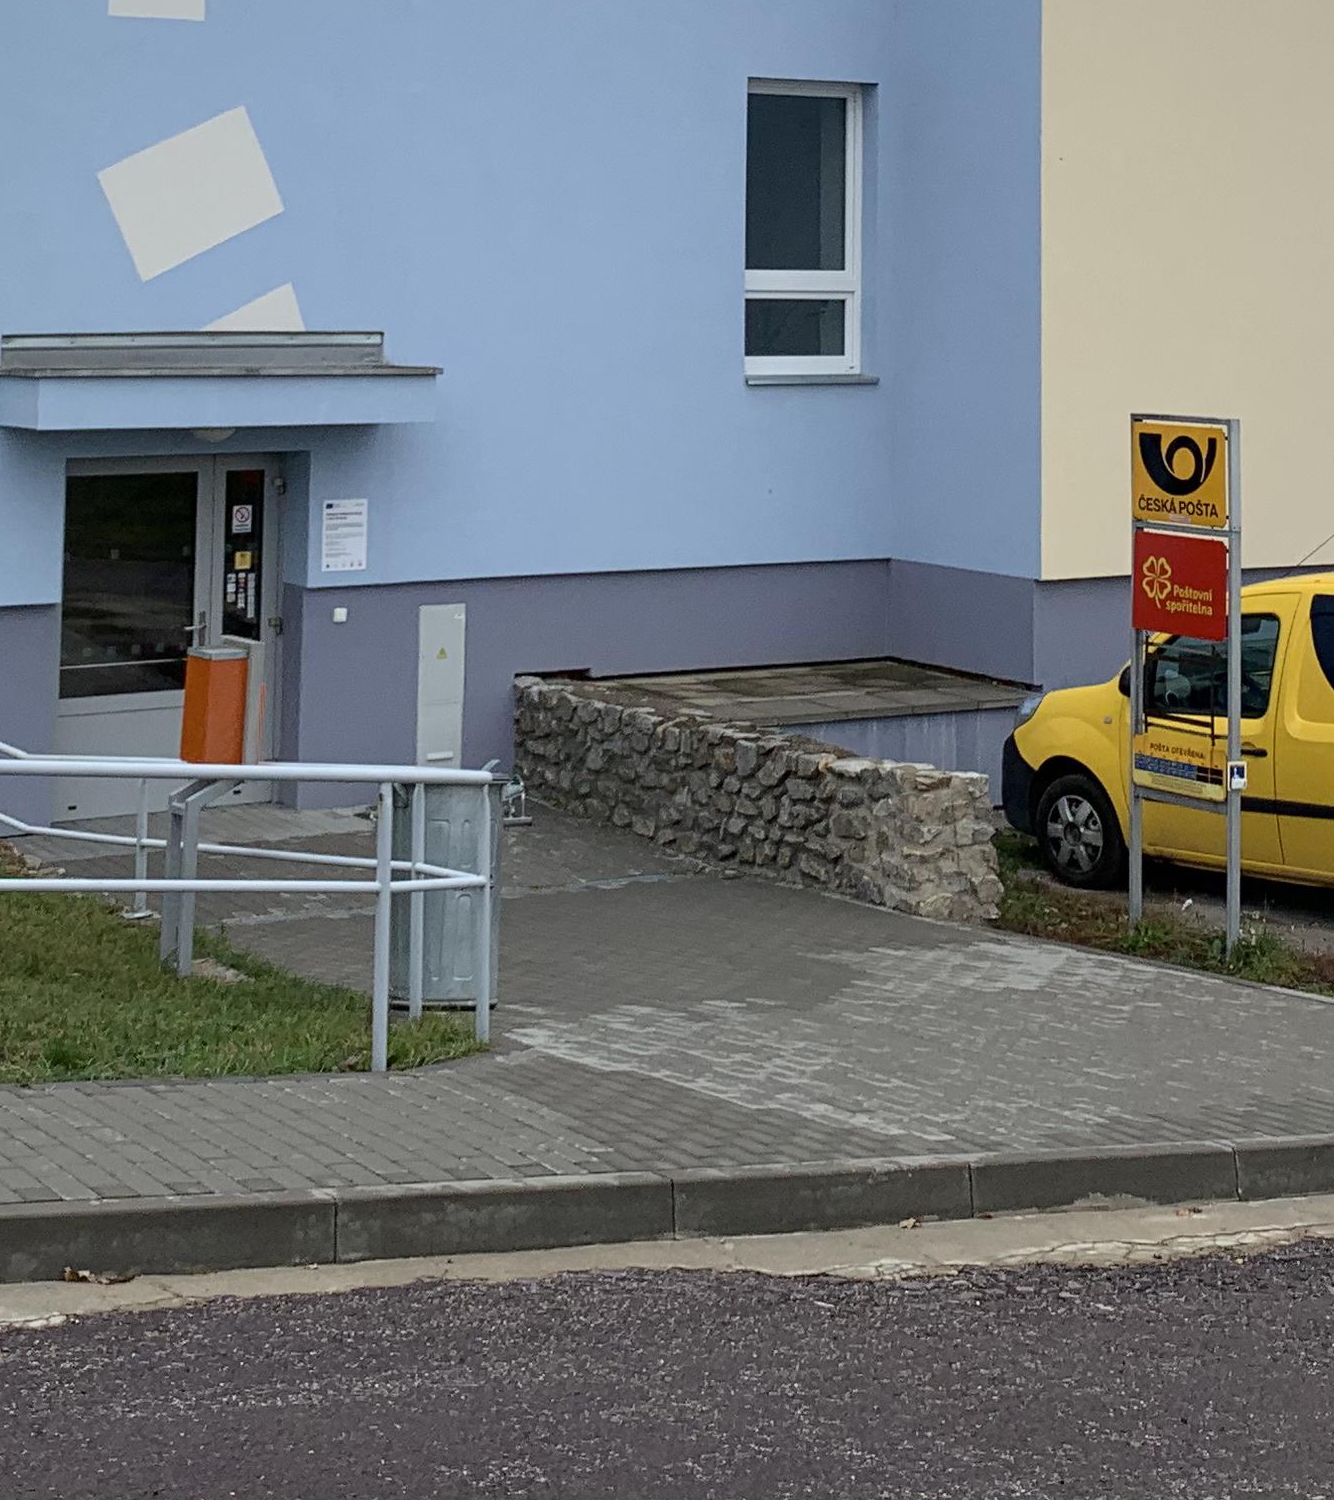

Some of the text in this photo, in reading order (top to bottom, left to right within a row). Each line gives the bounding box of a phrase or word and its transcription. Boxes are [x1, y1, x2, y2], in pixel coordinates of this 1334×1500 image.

[1138, 494, 1218, 518] ČESKÁ POŠTA
[1173, 584, 1213, 602] Poštovní
[1165, 599, 1213, 616] spořitelna
